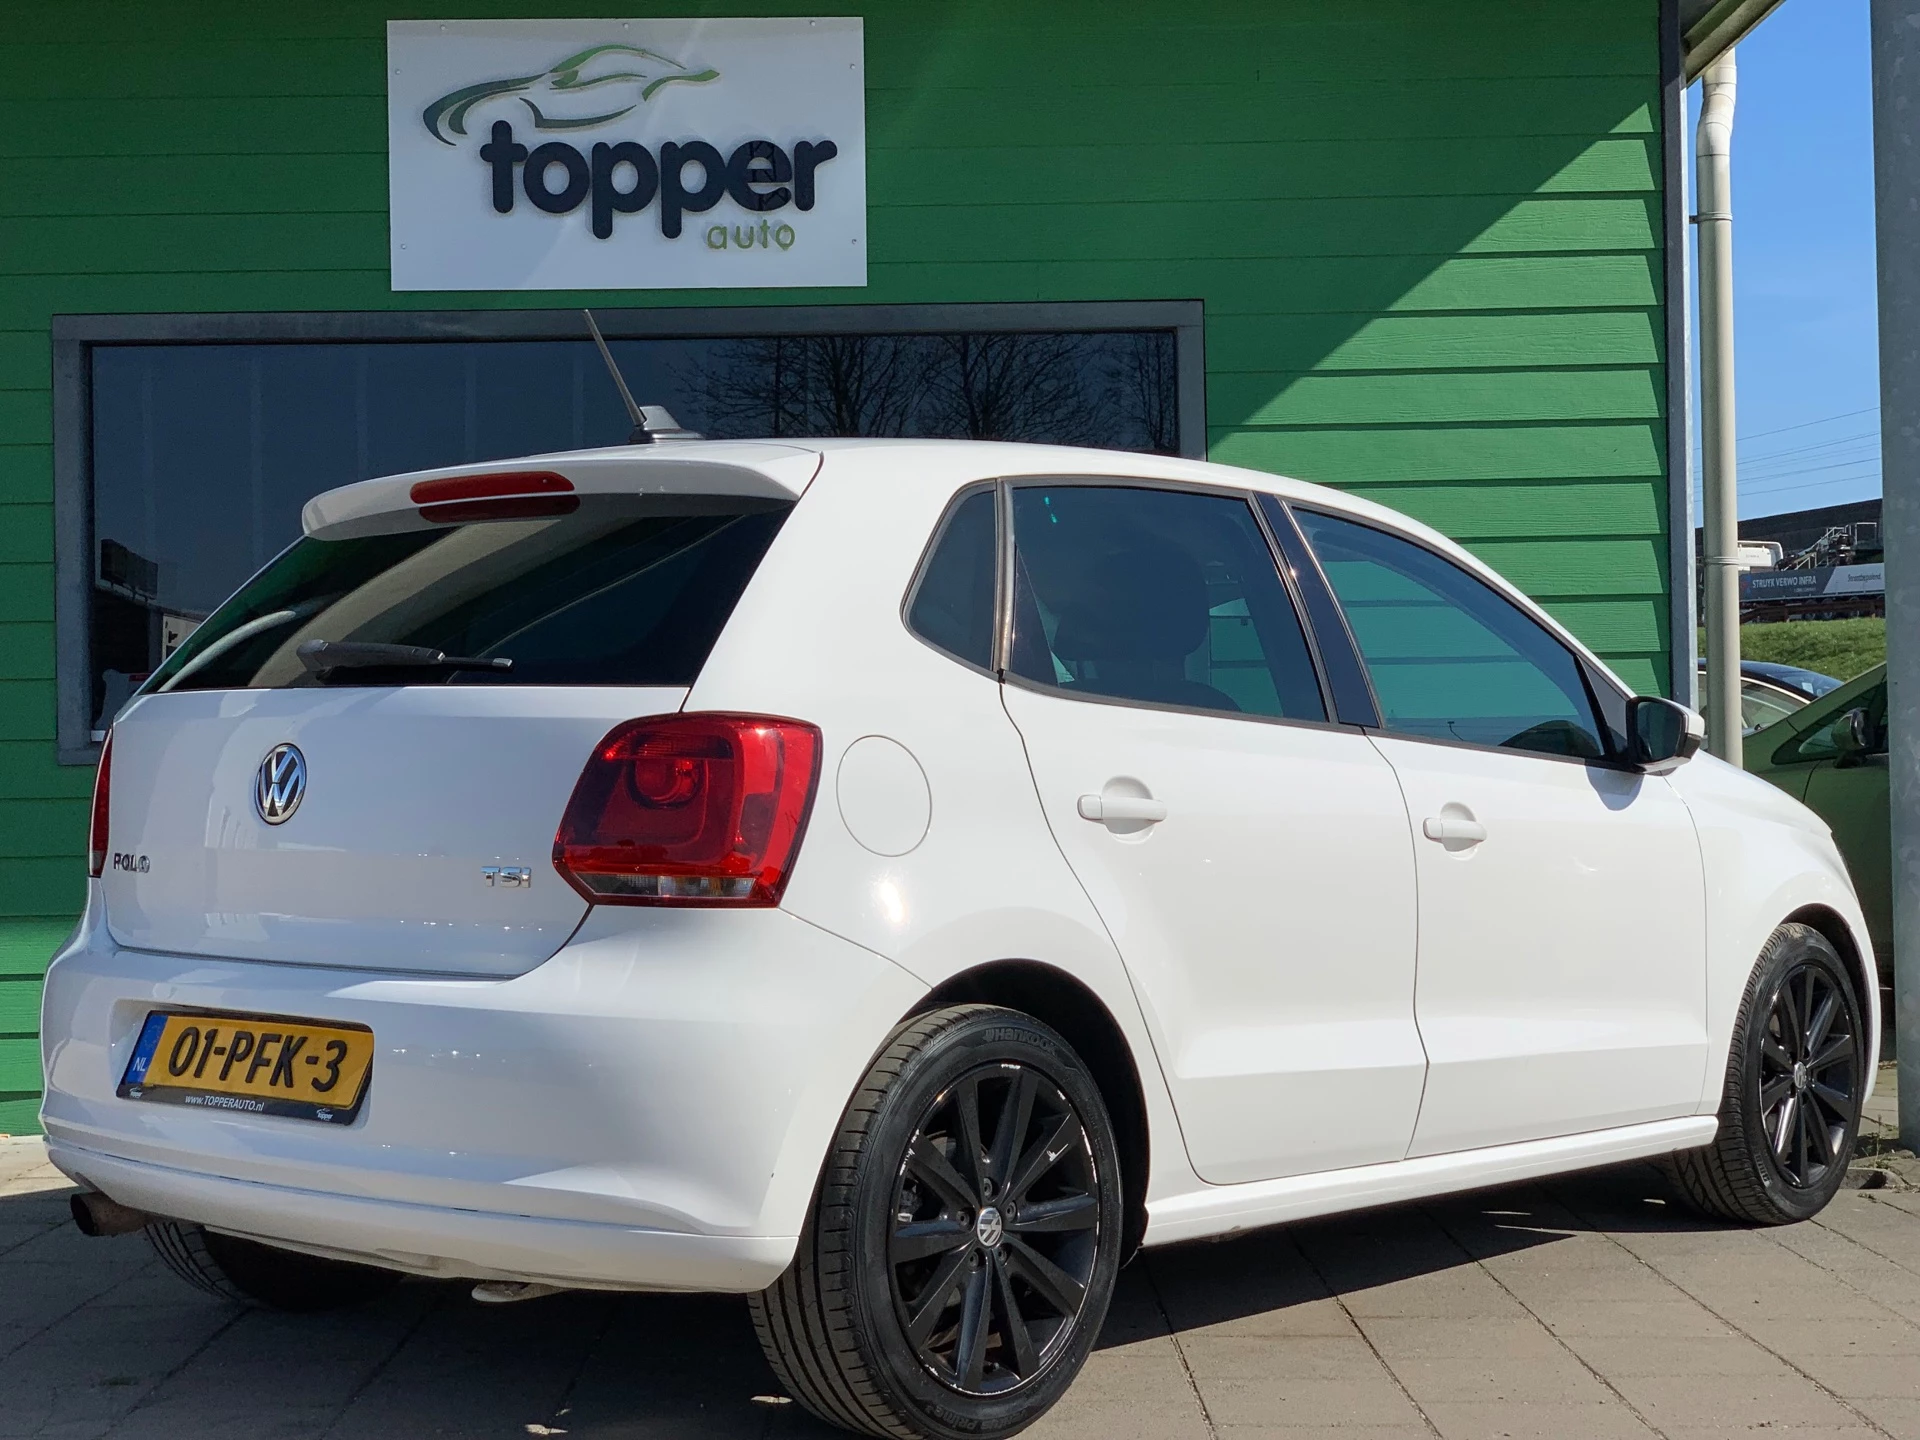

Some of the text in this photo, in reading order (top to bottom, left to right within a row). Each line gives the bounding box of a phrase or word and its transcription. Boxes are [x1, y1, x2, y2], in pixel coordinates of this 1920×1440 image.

[479, 119, 838, 240] topper
[706, 218, 796, 251] auto
[1776, 576, 1798, 587] VERWO
[1798, 575, 1817, 586] INFRA
[113, 852, 151, 873] POLO
[132, 1057, 147, 1072] NL
[168, 1026, 348, 1093] 01-PFK-3
[185, 1095, 265, 1112] www.TOPPERAUTO.nl
